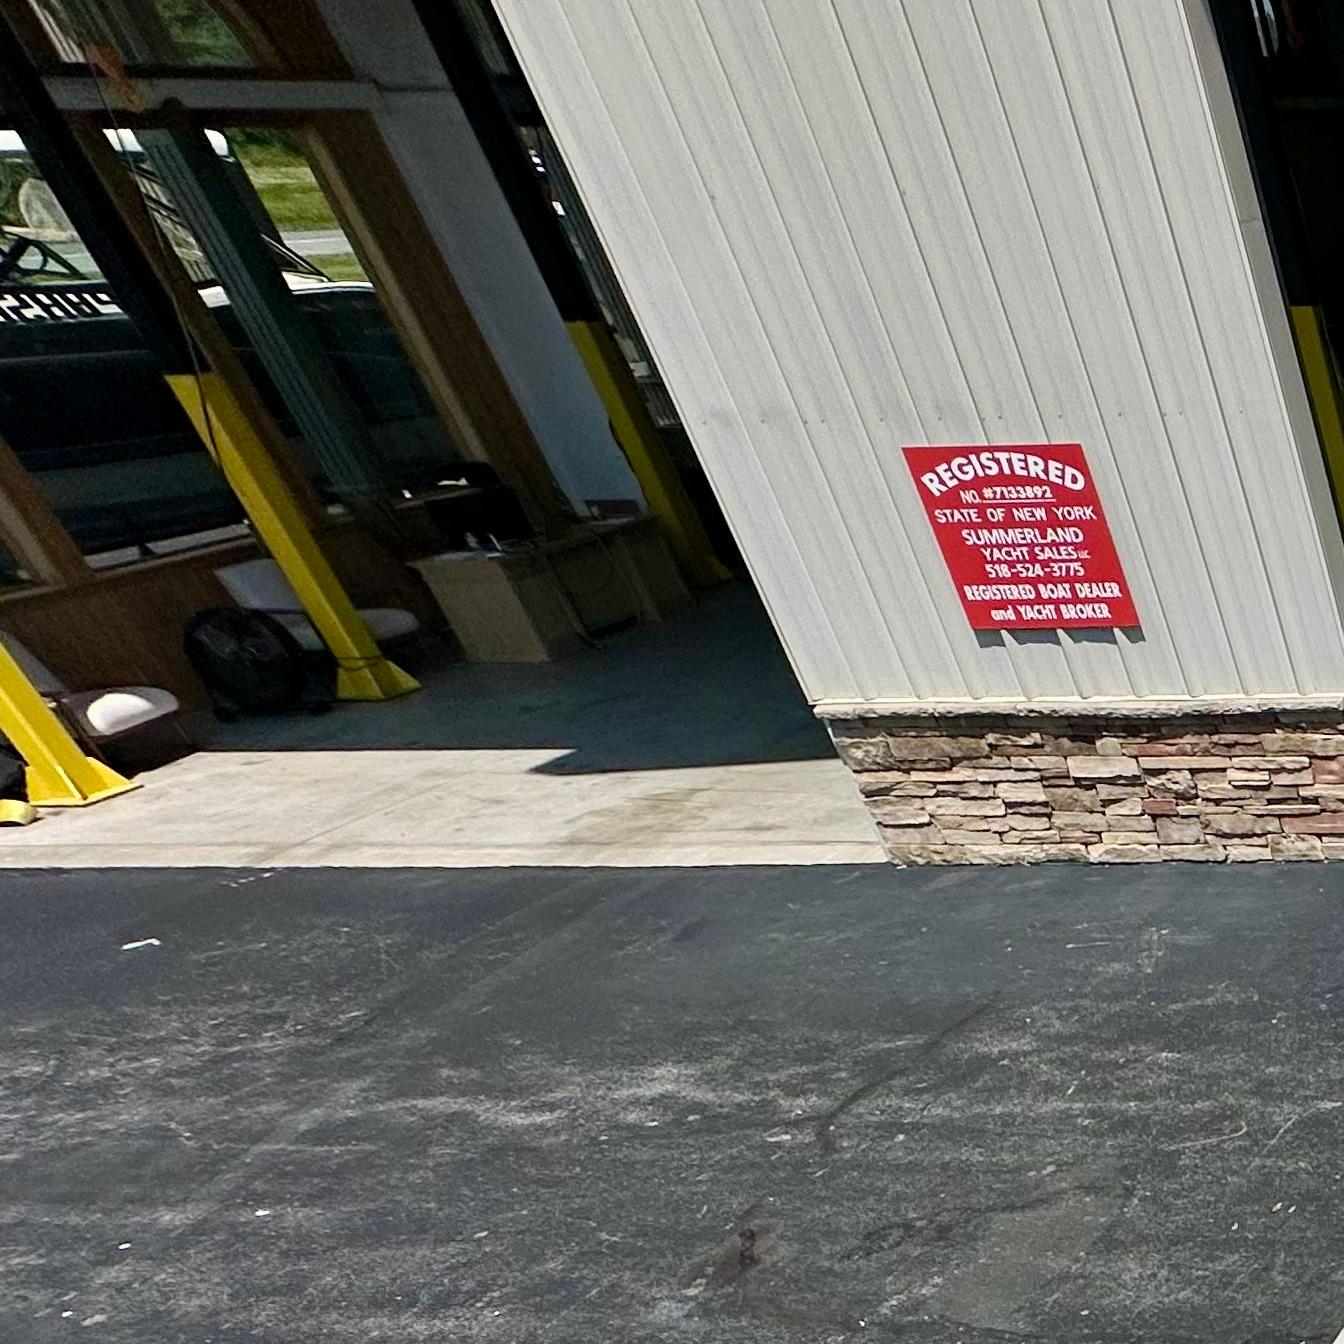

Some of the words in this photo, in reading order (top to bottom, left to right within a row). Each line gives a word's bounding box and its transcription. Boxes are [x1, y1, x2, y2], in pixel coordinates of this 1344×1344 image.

[920, 451, 1086, 497] REGISTERED
[959, 490, 981, 504] NO.
[934, 508, 982, 524] STATE
[986, 507, 1007, 522] OF
[1012, 506, 1048, 522] NEW
[1053, 505, 1098, 521] YORK
[961, 526, 1084, 546] SUMMERLAND
[980, 547, 1030, 561] YACHT
[1034, 546, 1078, 561] SALES
[984, 562, 1085, 578] 518-524-3775
[963, 584, 1035, 601] REGISTERED
[1037, 583, 1072, 600] BOAT
[1074, 582, 1122, 598] DEALER
[990, 605, 1016, 621] and
[1018, 605, 1058, 620] YACHT
[1060, 603, 1112, 620] BROKER
